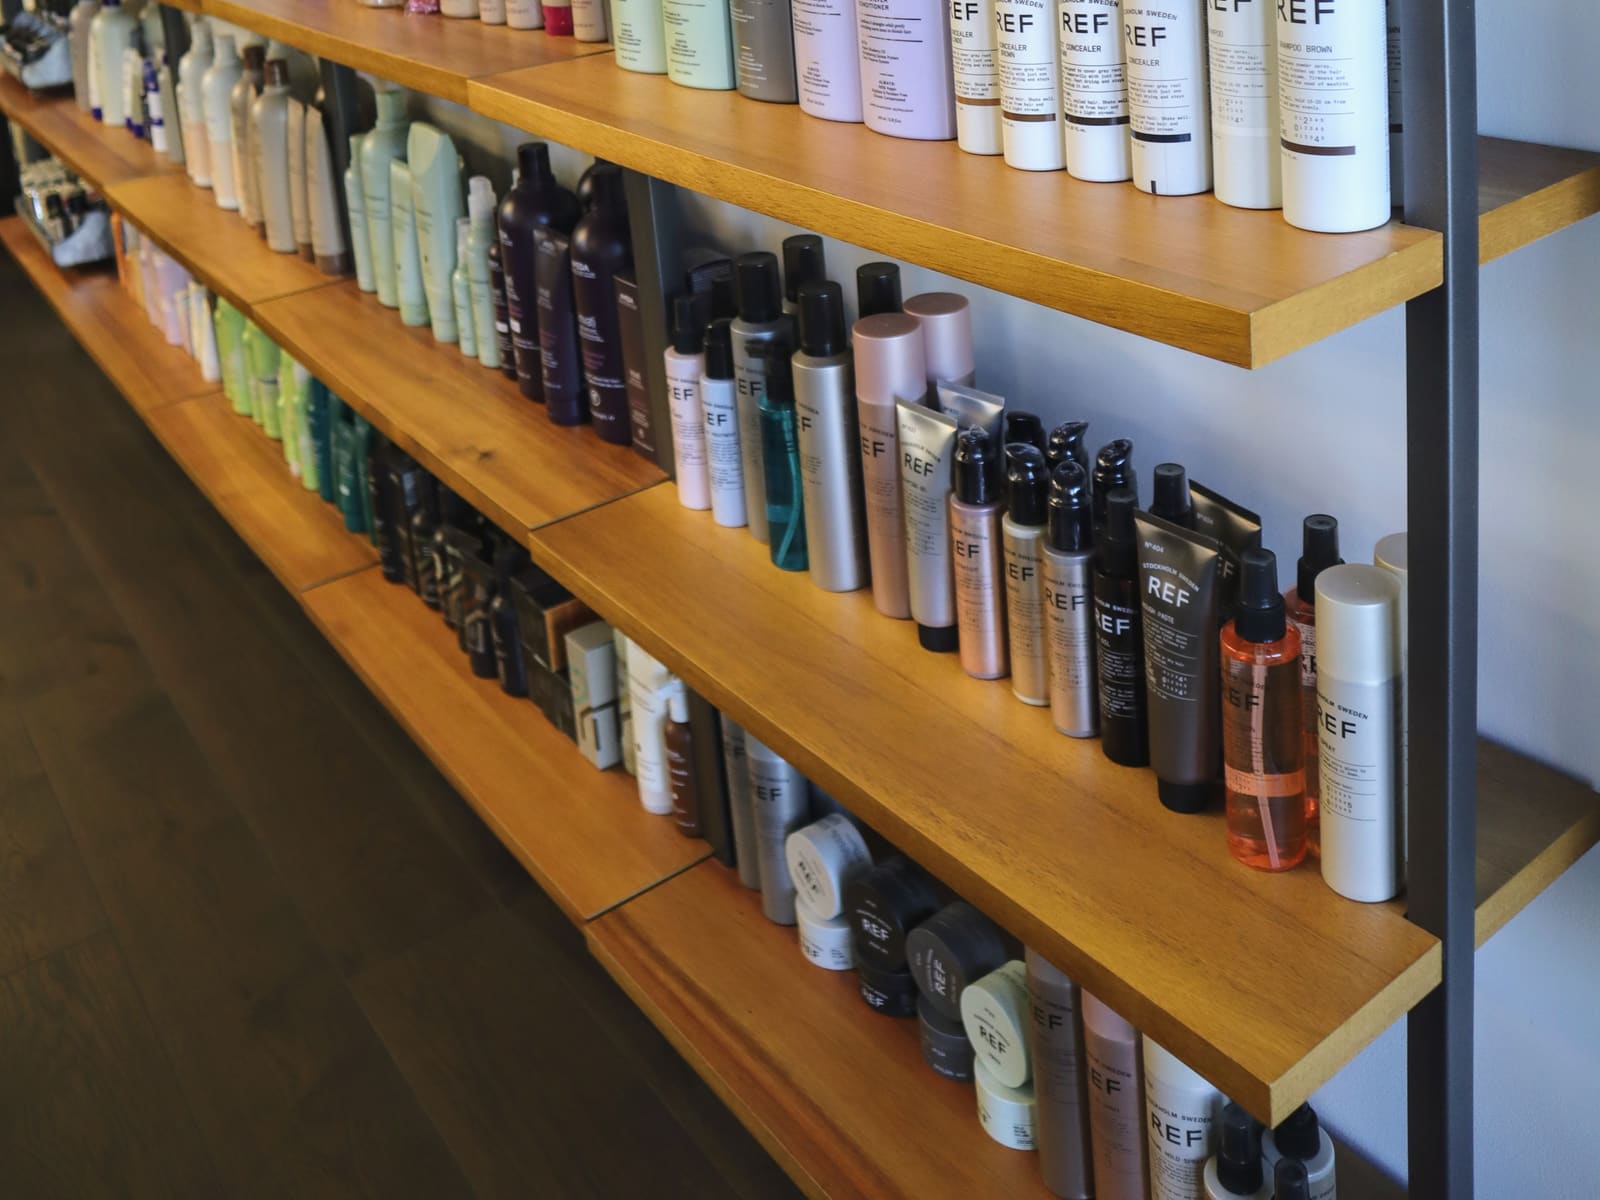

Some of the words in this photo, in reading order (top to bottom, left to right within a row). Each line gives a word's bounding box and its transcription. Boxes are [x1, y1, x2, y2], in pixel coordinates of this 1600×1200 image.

[1062, 11, 1109, 34] REF
[1146, 10, 1177, 20] SWEDEN
[1125, 24, 1167, 47] REF
[1066, 43, 1102, 53] CONCEALER
[1306, 43, 1333, 53] BROWN
[668, 385, 693, 401] EF
[738, 379, 763, 397] EF
[706, 413, 727, 427] EF
[861, 437, 885, 458] EF
[904, 453, 934, 477] REF
[956, 540, 980, 559] EF
[1142, 562, 1177, 575] STOCKHOLM
[1178, 572, 1199, 592] SWEDEN
[1148, 575, 1190, 608] REF
[1229, 689, 1260, 713] EF
[1337, 704, 1369, 720] SWEDEN
[757, 786, 782, 801] EF
[1034, 1006, 1063, 1030] EF
[980, 1025, 1007, 1054] REF
[1091, 1068, 1121, 1095] EF
[1151, 1111, 1203, 1147] REF
[1181, 1115, 1212, 1124] SWEDEN
